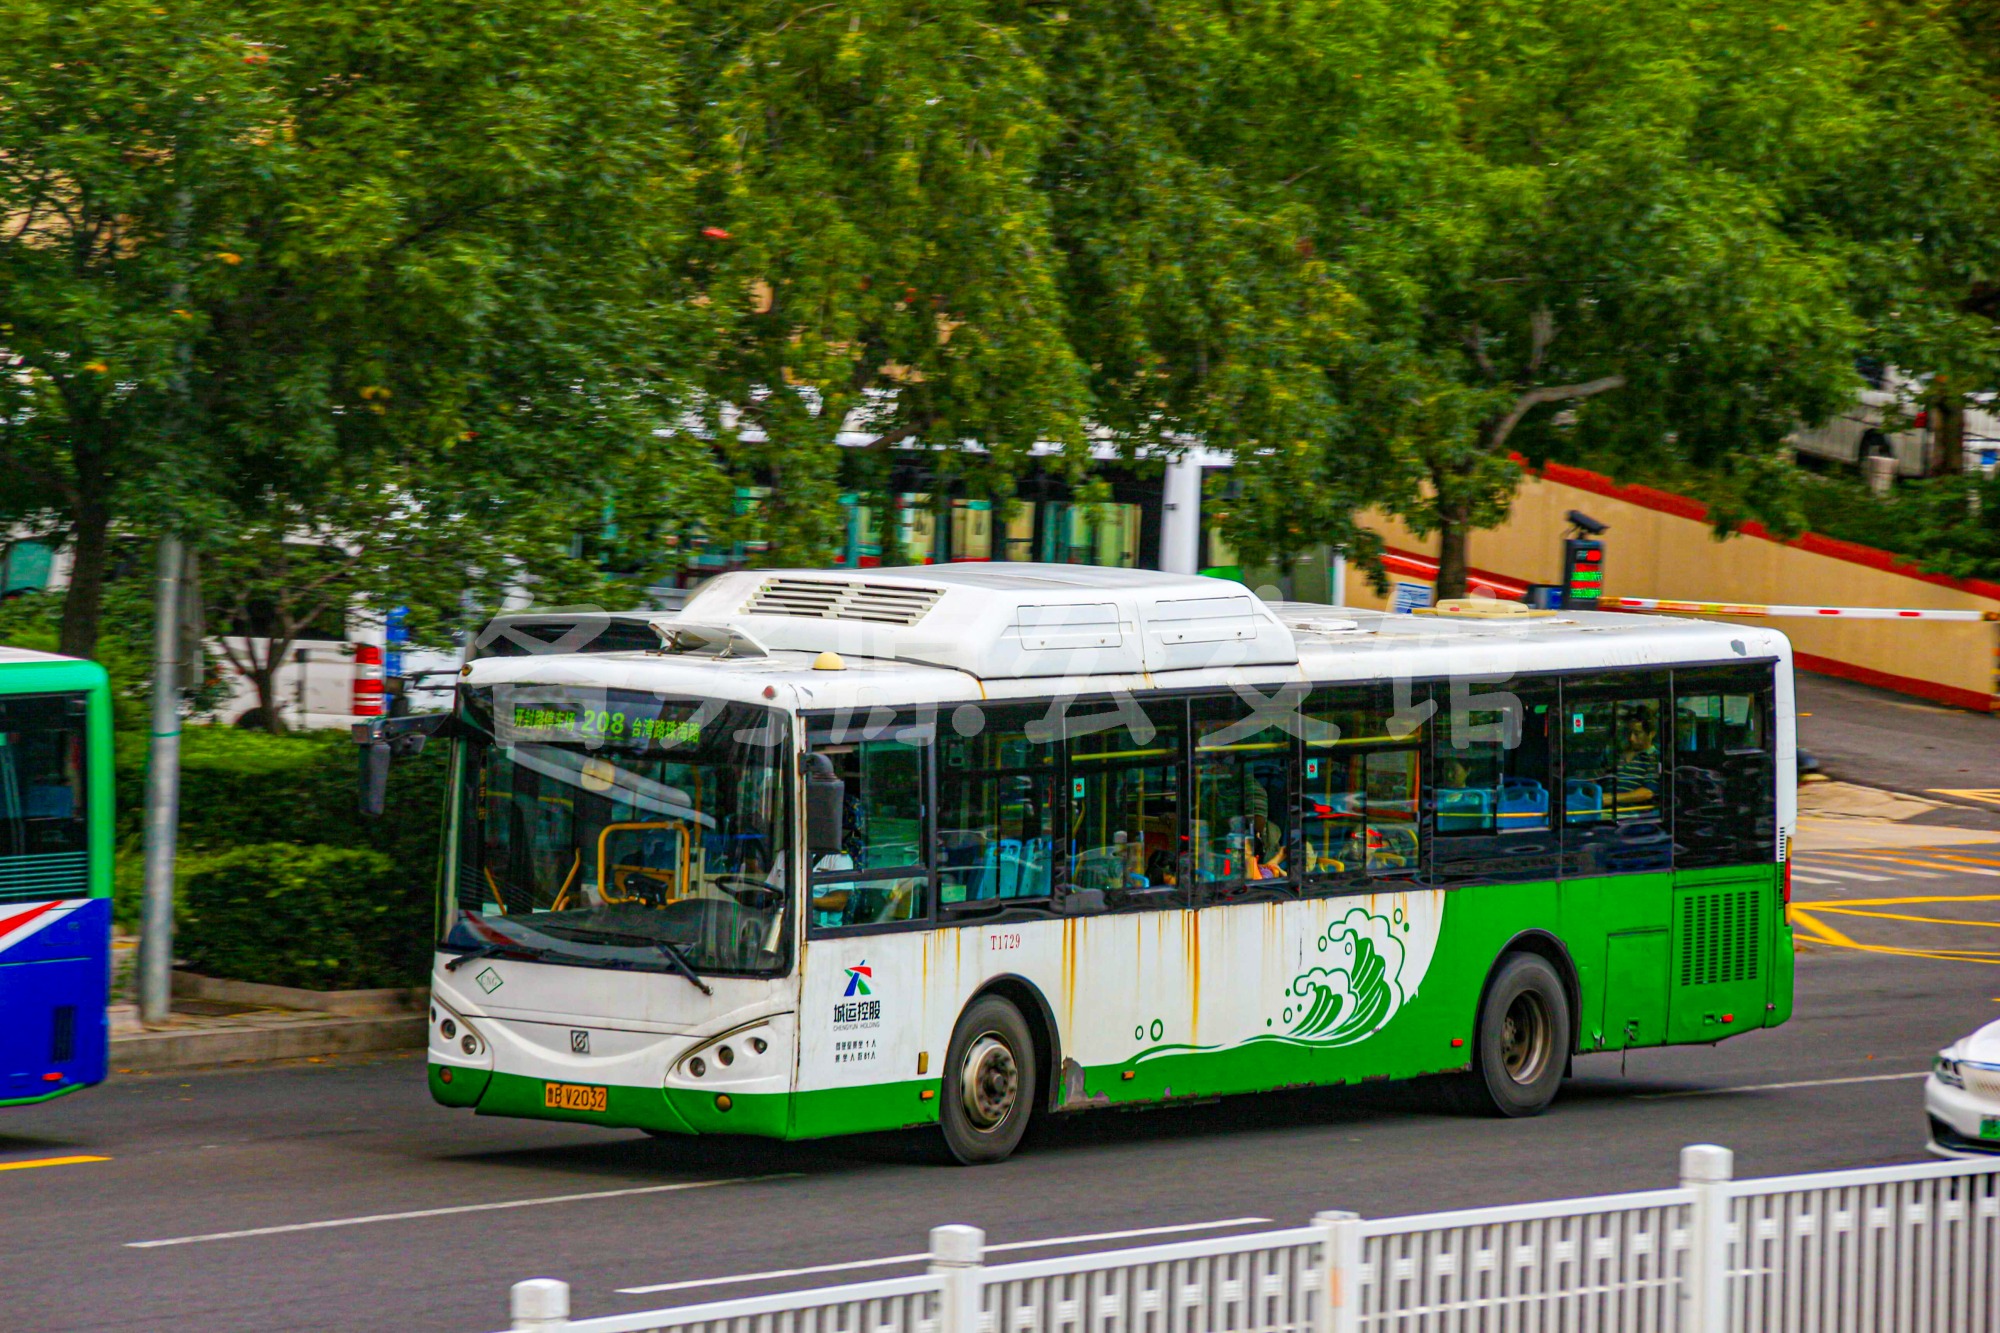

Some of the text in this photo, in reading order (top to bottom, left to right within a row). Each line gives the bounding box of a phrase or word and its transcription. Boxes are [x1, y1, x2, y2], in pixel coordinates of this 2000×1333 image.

[581, 709, 626, 735] 208
[631, 716, 701, 744] 台湾路珠海路
[990, 933, 1021, 951] T1729
[833, 1000, 881, 1023] 城运控股
[833, 1021, 880, 1032] CHENGYUN HOLDING
